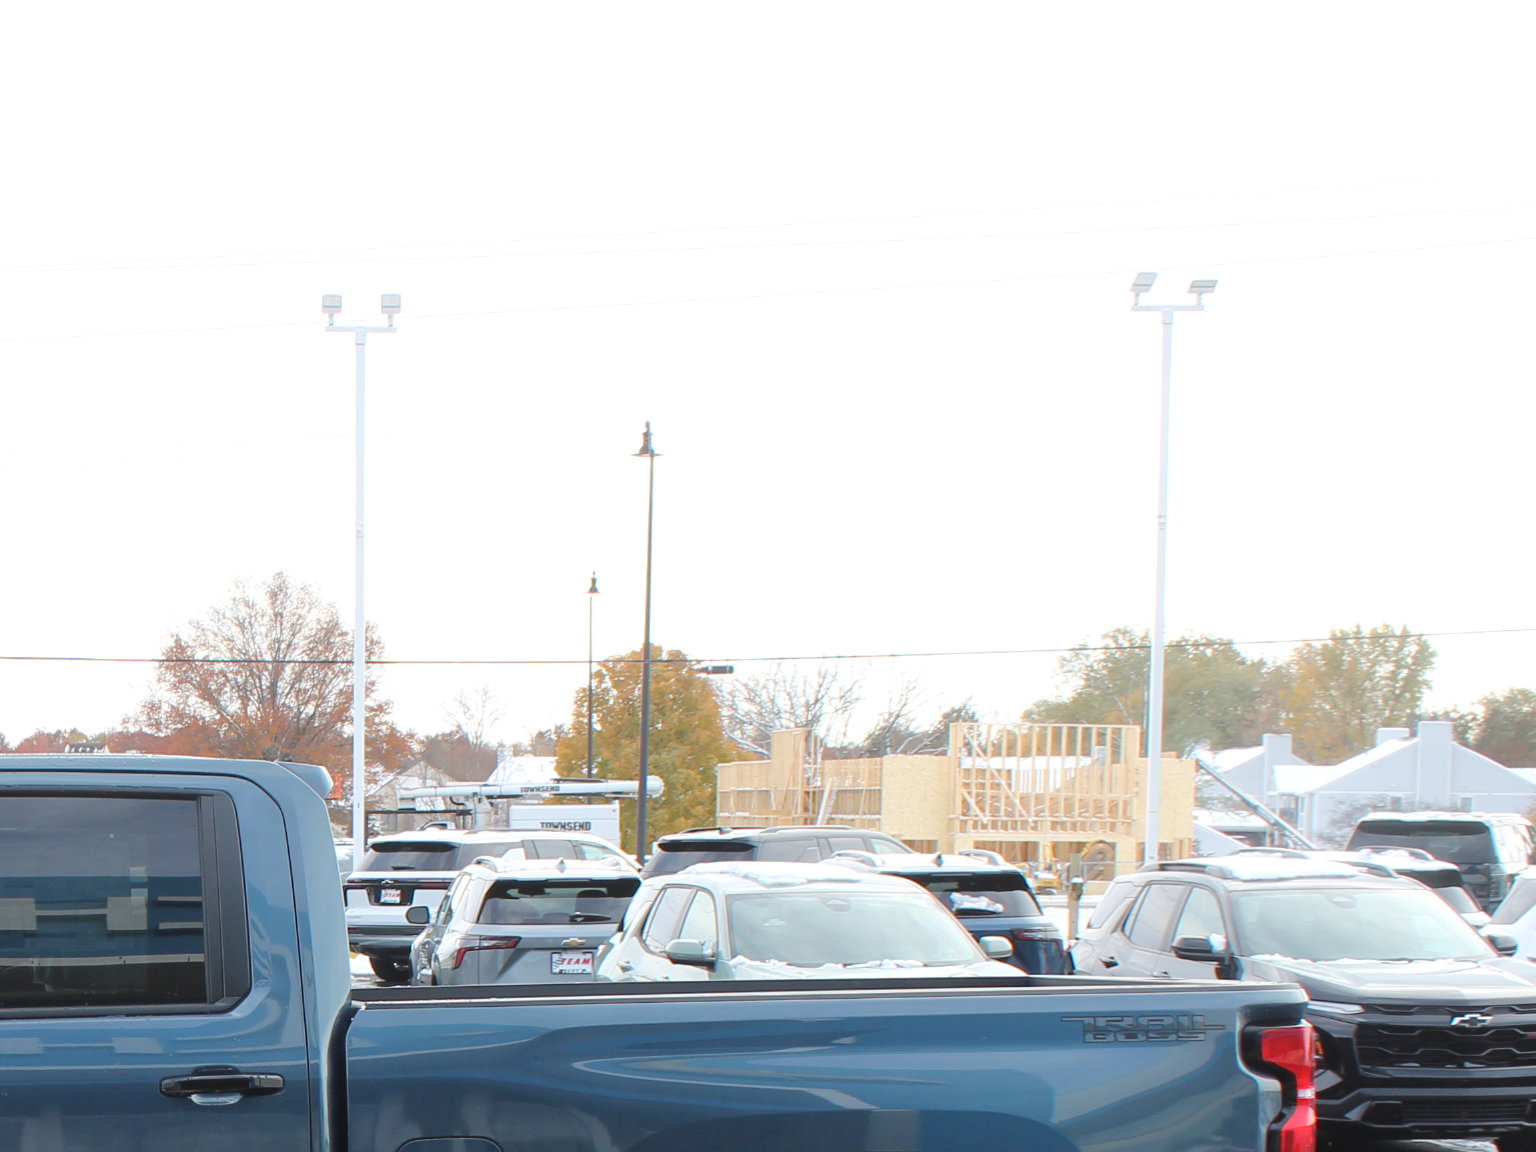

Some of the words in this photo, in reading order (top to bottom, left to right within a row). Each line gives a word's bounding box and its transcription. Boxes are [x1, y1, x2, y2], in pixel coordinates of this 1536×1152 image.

[540, 821, 592, 831] TOWNSEND
[1060, 1014, 1226, 1030] TRAIL
[1083, 1030, 1207, 1043] BOSS
